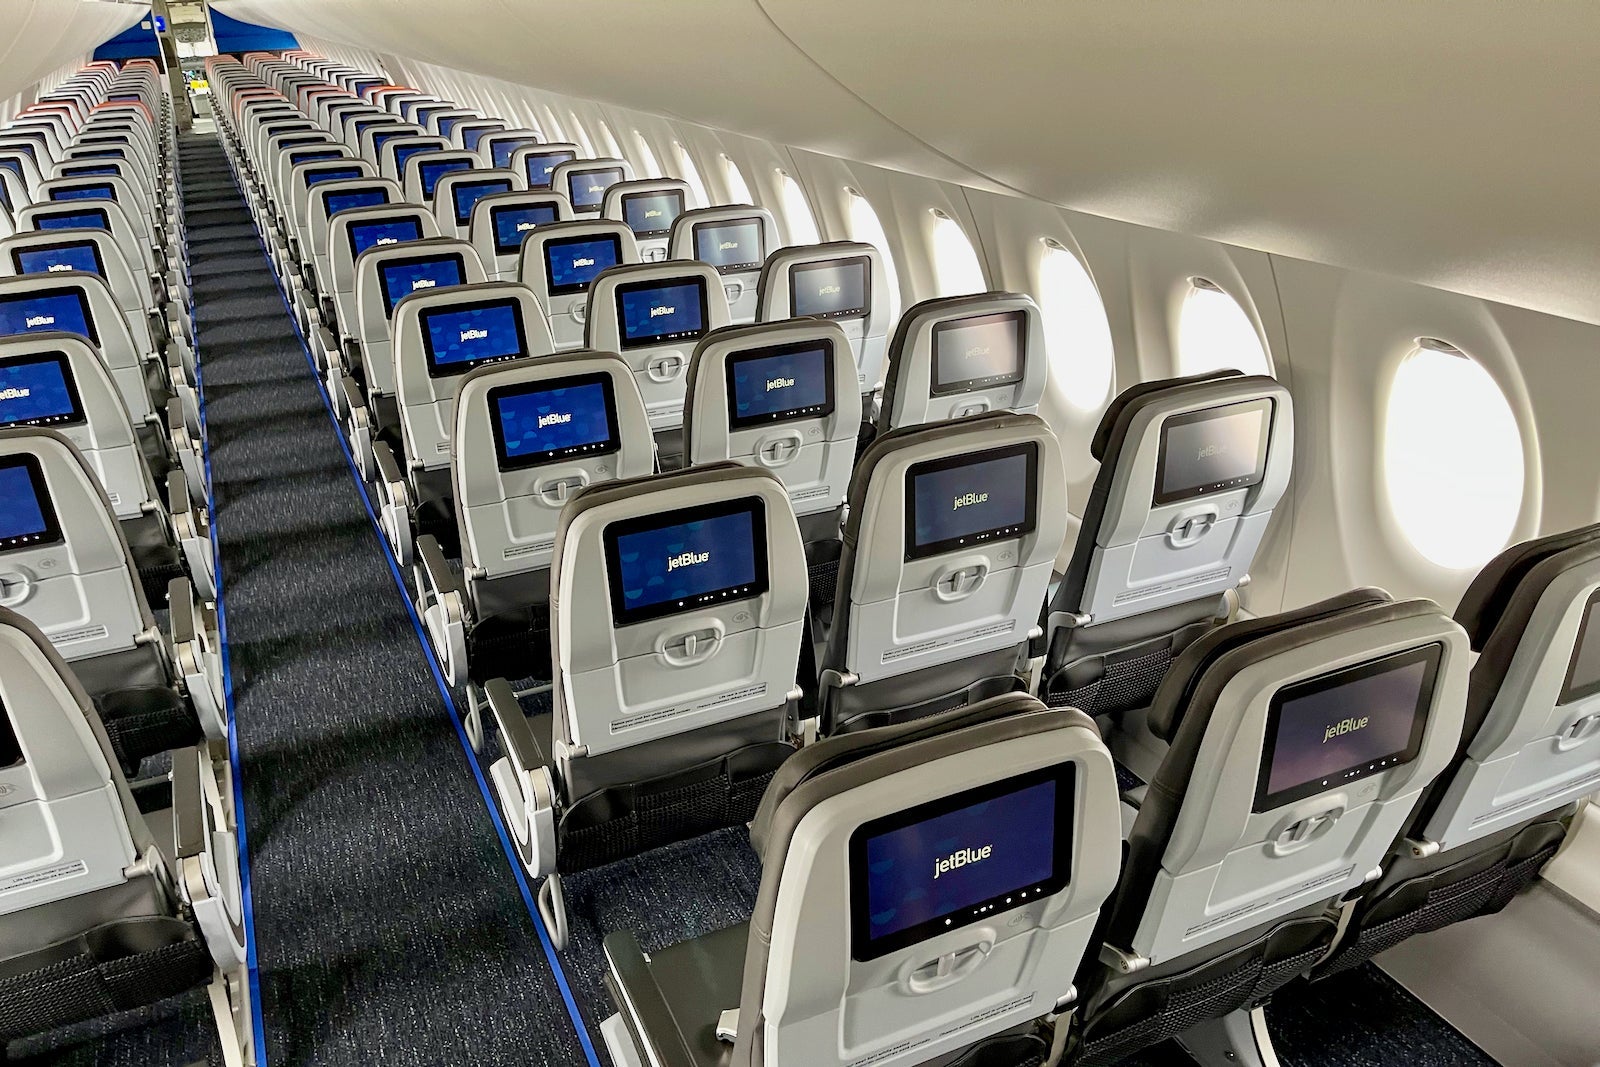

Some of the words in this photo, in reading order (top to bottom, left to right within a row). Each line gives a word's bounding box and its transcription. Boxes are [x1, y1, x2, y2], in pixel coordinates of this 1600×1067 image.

[651, 306, 674, 318] jetBlue
[26, 316, 54, 328] jetBlue
[461, 330, 487, 342] jetBlue
[767, 378, 795, 391] jetBlue
[0, 387, 30, 401] etBlue
[538, 413, 571, 429] jetBlue
[953, 492, 988, 510] jetBlue
[668, 552, 709, 572] jetBlue
[1322, 716, 1369, 744] jetBlue
[934, 844, 992, 880] jetBlue
